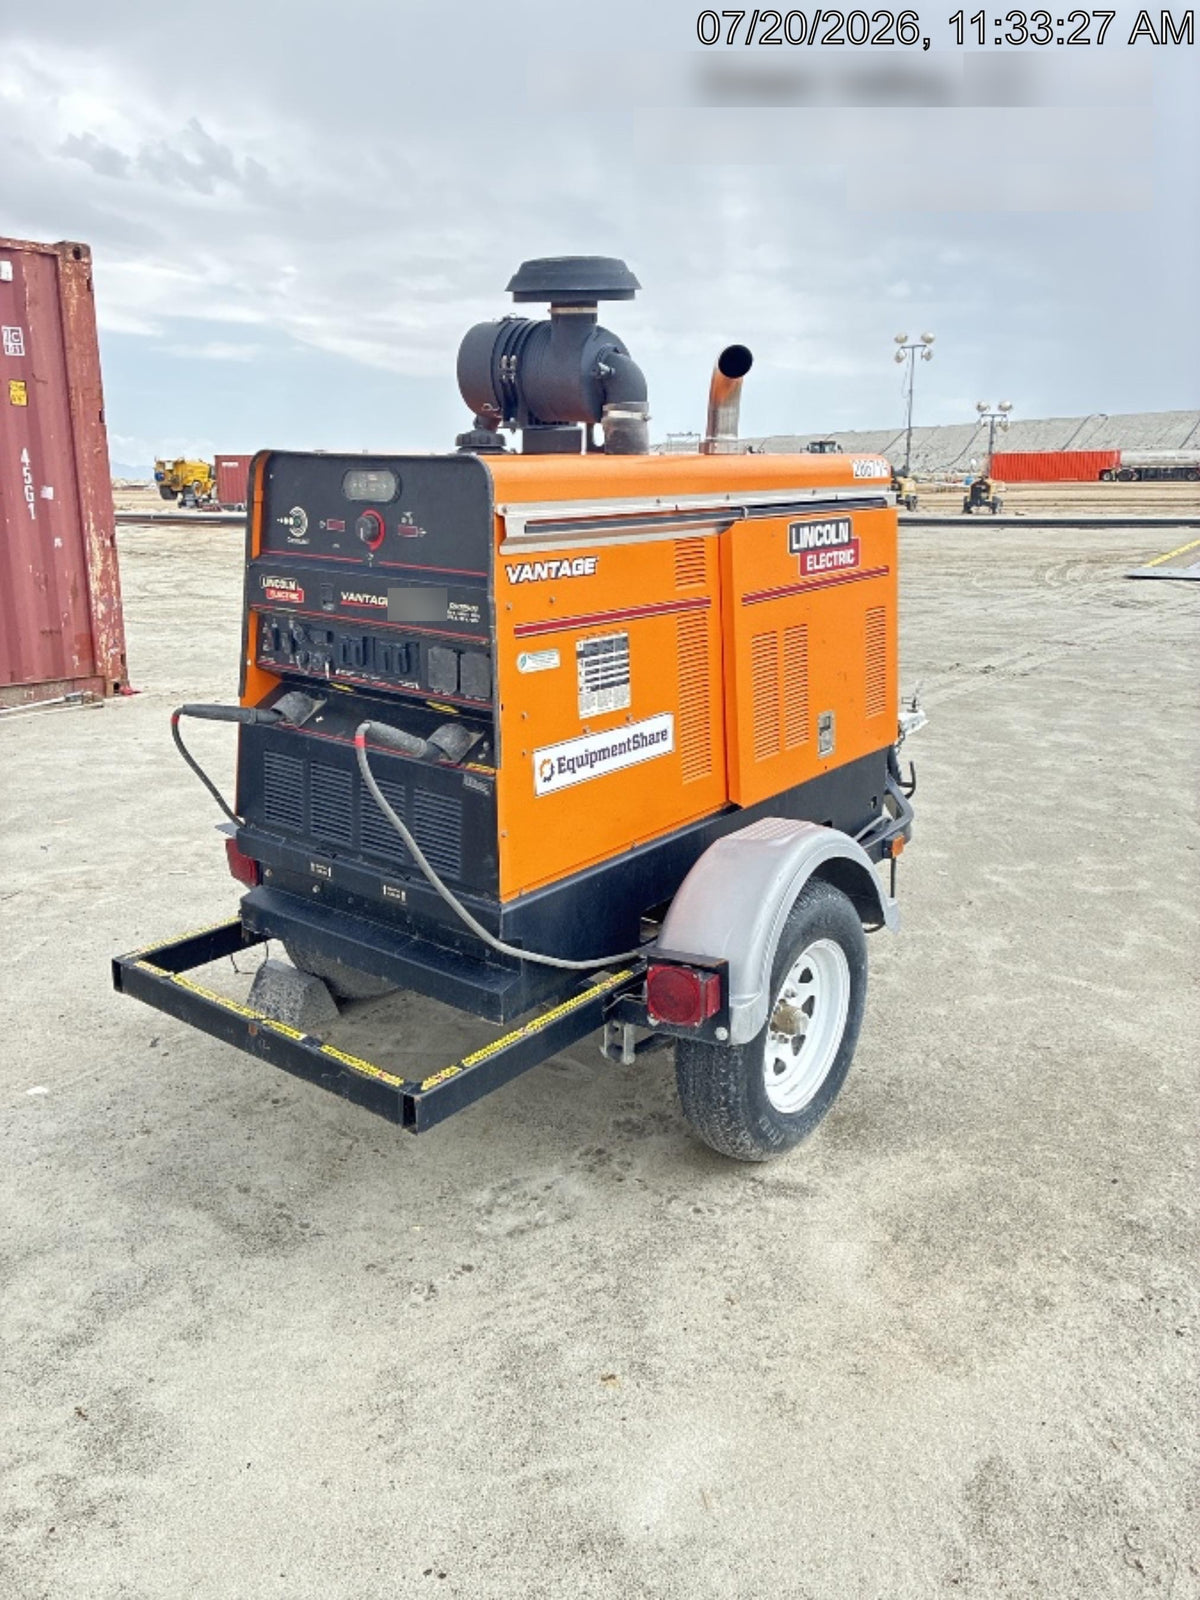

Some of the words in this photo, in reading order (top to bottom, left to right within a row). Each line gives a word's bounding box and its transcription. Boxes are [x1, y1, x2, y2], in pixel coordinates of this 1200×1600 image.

[20, 447, 36, 520] 45G1
[791, 521, 850, 551] LINCOLN
[505, 556, 599, 585] VANTAGE
[805, 549, 856, 572] ELECTRIC
[340, 591, 388, 608] VANTAG
[556, 727, 669, 775] EquipmentShare
